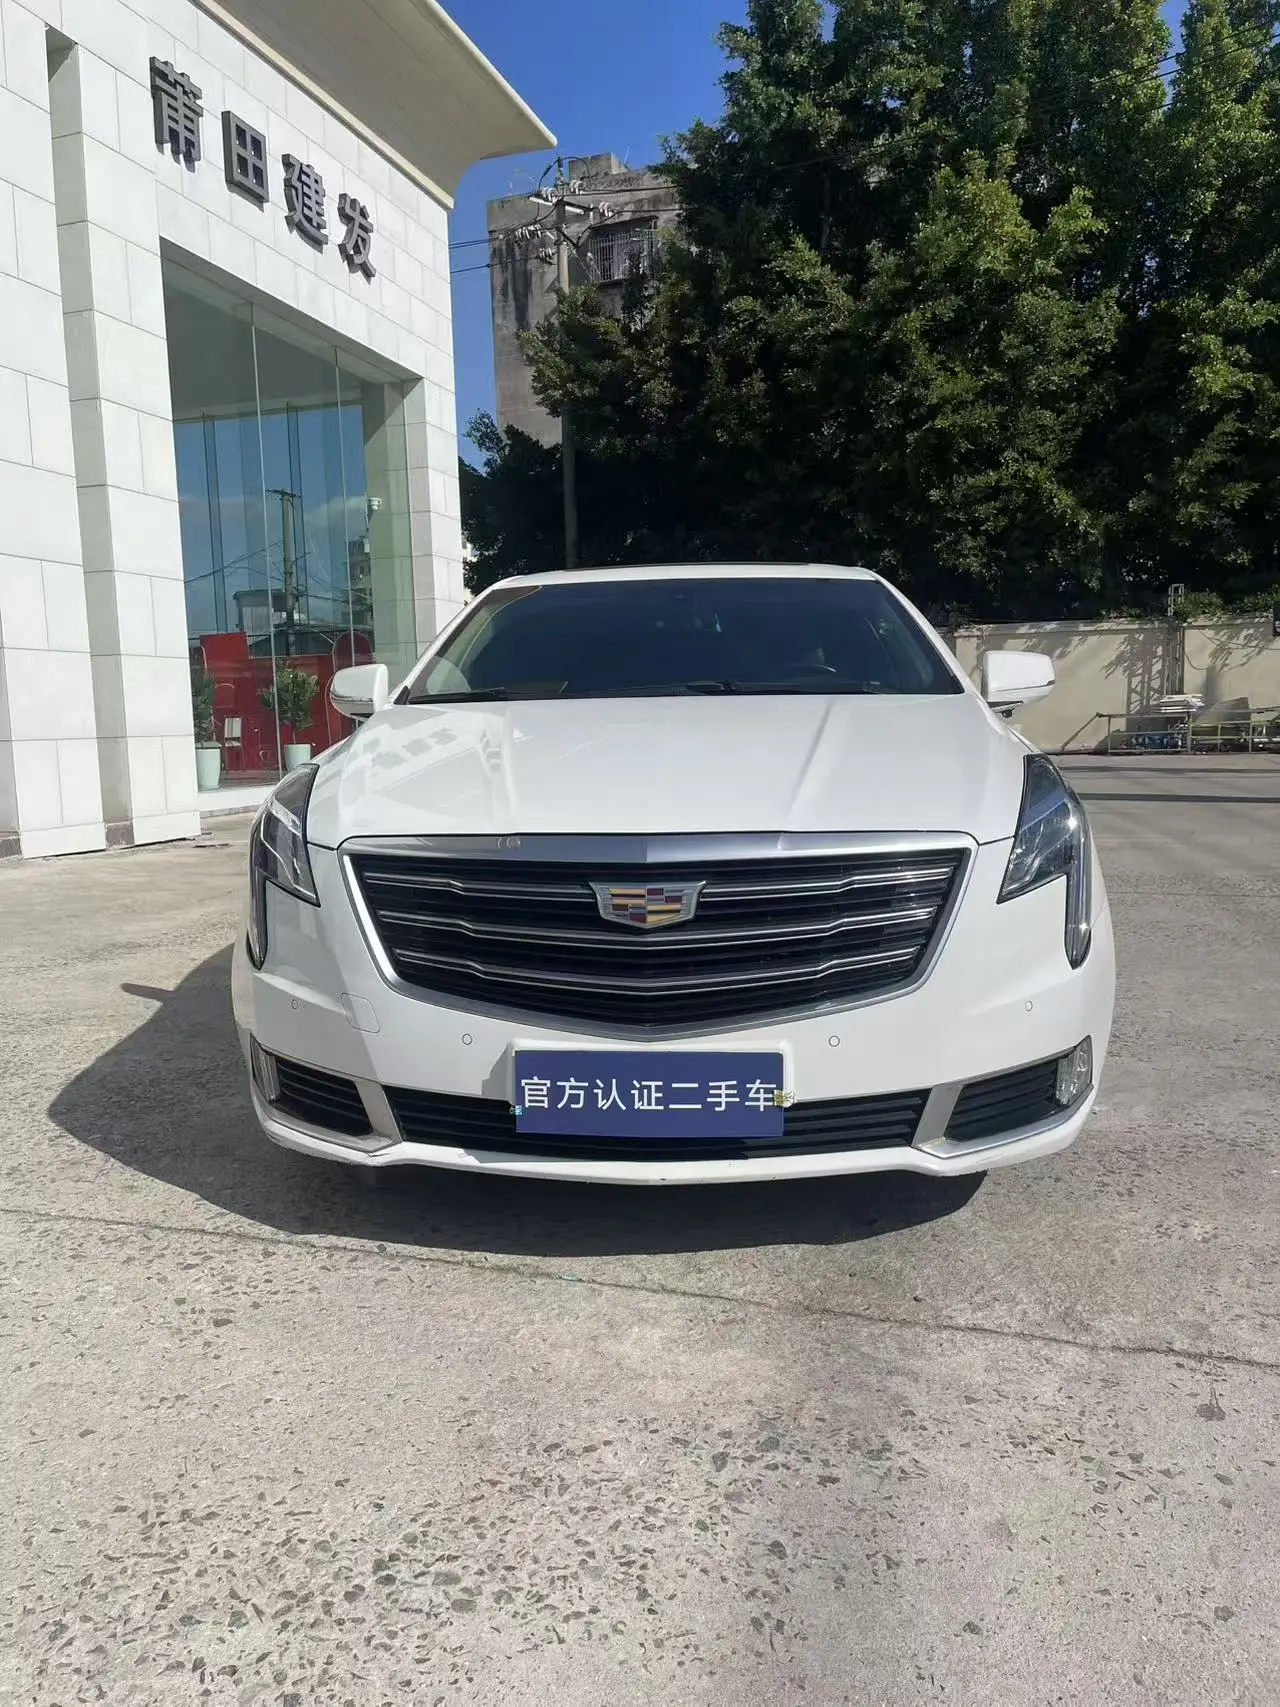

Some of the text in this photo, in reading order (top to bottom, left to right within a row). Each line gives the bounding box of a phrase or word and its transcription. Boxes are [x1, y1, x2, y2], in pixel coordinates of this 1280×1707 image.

[149, 56, 377, 279] 莆田建发
[520, 1076, 777, 1112] 官方认证二手车
